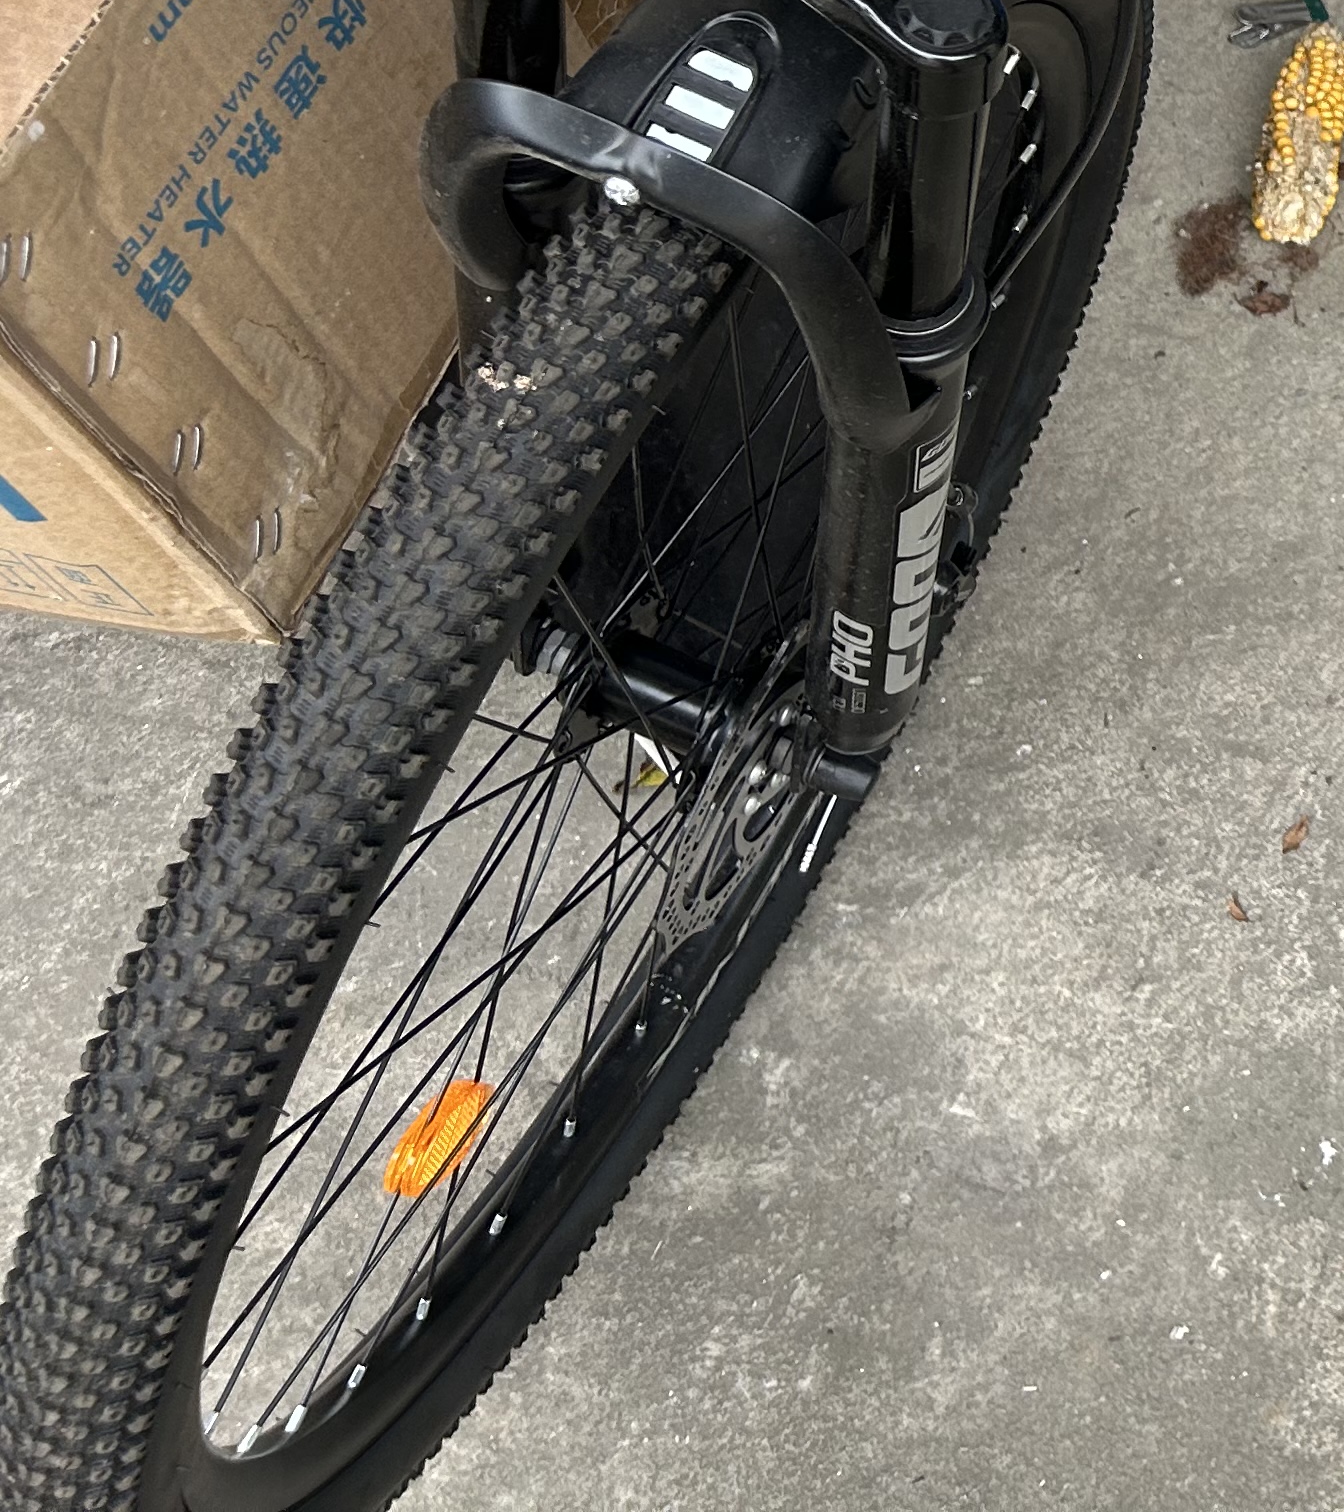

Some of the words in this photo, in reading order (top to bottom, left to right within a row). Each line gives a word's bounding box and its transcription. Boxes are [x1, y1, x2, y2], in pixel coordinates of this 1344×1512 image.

[186, 70, 261, 166] WATER
[111, 165, 193, 278] HEATER
[831, 609, 874, 687] PHO
